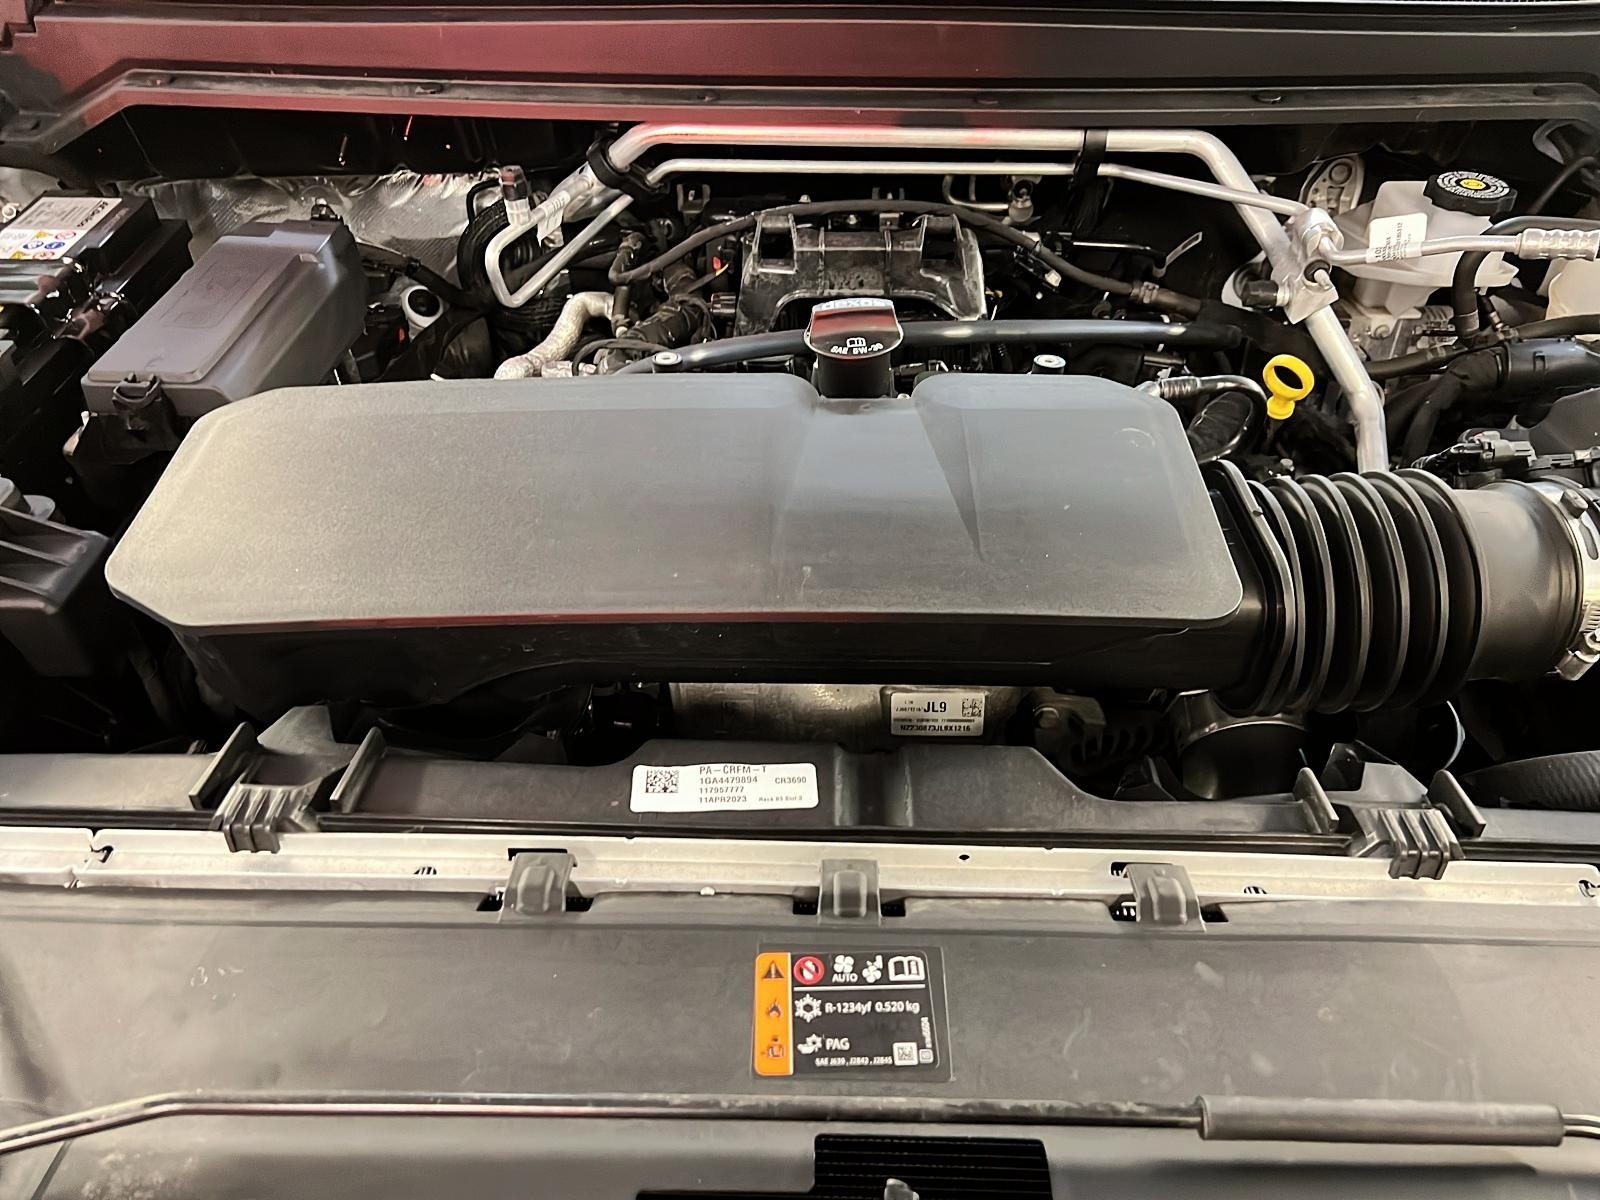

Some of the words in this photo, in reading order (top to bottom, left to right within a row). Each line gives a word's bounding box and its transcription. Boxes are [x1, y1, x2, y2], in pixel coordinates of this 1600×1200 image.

[923, 701, 947, 713] JL9
[700, 765, 766, 774] PA-CRFM-T
[700, 776, 758, 785] 1GA4479894
[774, 776, 807, 785] CR3690
[699, 786, 745, 794] 117957777
[832, 972, 859, 983] AUTO
[825, 1001, 872, 1015] R-1234yf
[874, 1001, 905, 1013] 0.520
[905, 1000, 920, 1014] kg
[825, 1038, 850, 1050] PAG
[815, 1057, 829, 1066] SAE
